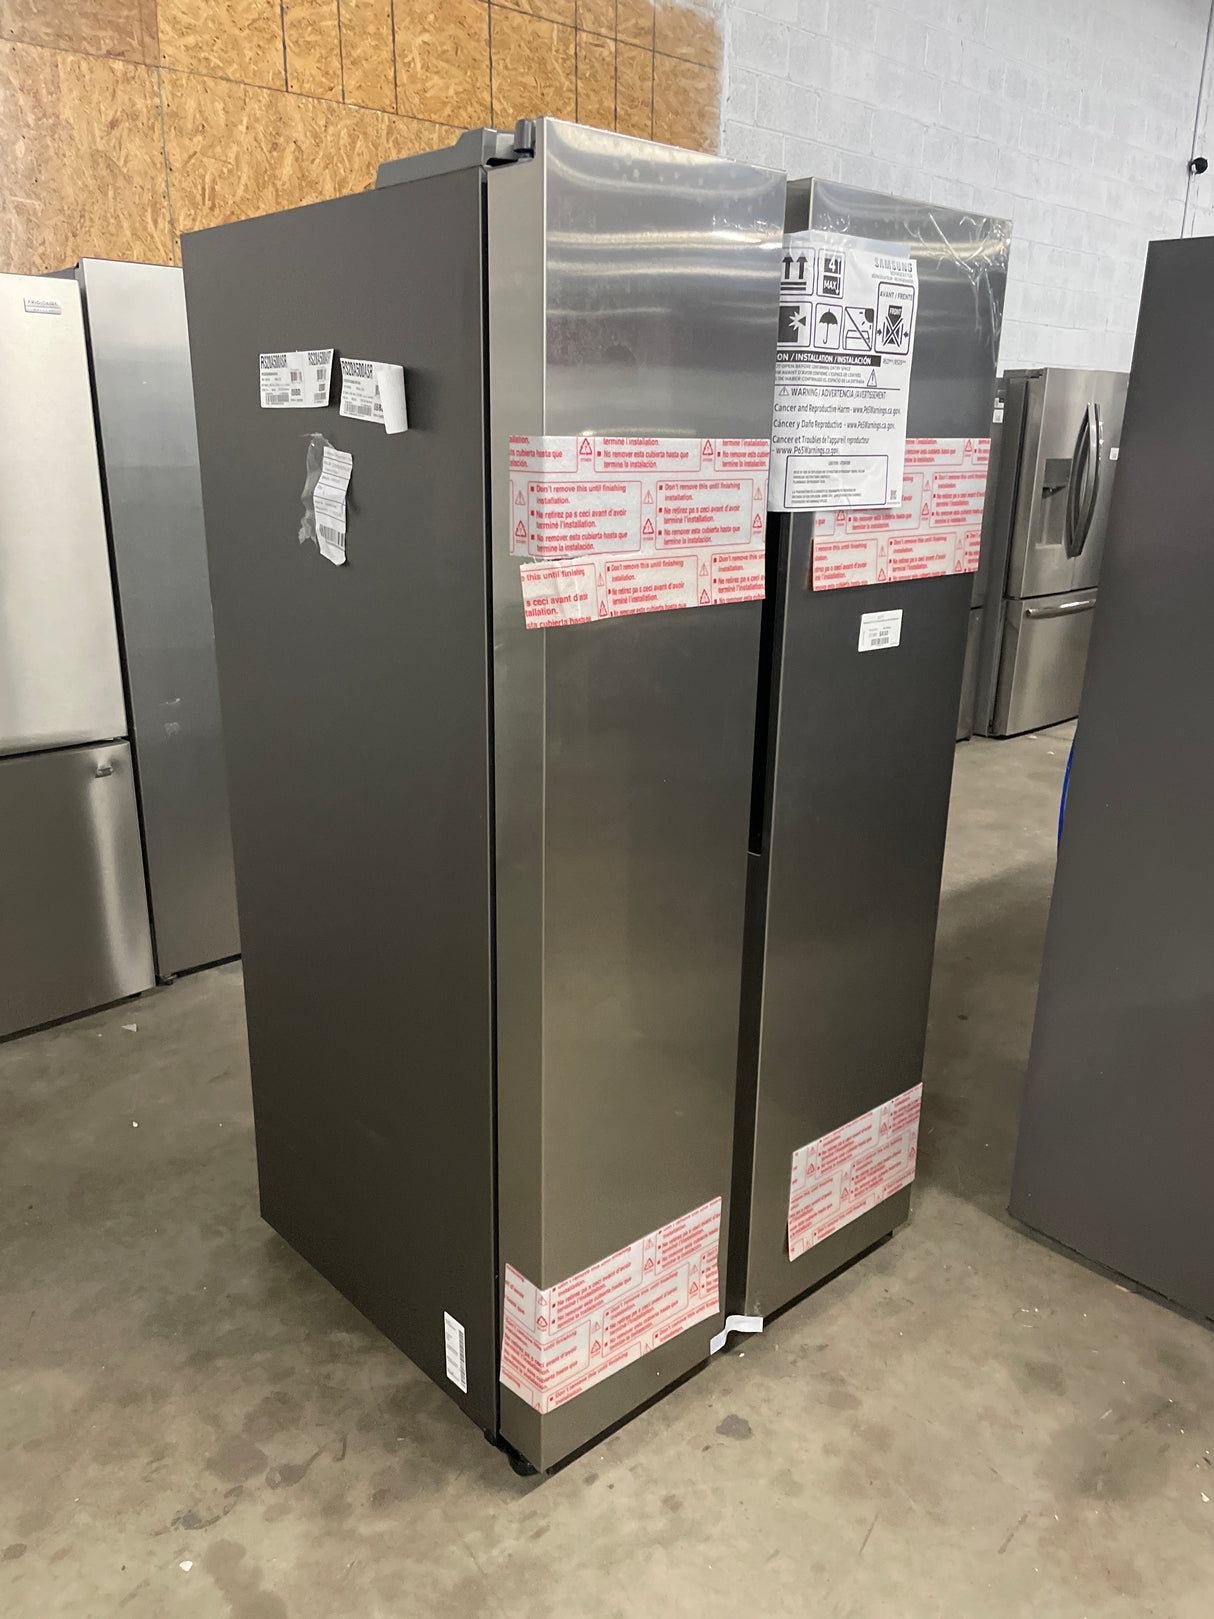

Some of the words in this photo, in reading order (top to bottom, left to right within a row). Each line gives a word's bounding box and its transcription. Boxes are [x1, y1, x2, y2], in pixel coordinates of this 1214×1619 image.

[829, 255, 836, 272] 4
[874, 257, 913, 273] SAMSUNG
[823, 280, 837, 290] MAX
[795, 354, 833, 364] INSTALLATION
[791, 387, 818, 398] WARNING
[774, 403, 796, 412] Cancer
[797, 404, 808, 412] and
[809, 404, 837, 414] Reproductive
[773, 419, 796, 428] Cáncer
[796, 422, 801, 430] y
[801, 420, 814, 429] Daño
[772, 435, 794, 444] Cancer
[794, 436, 802, 444] et
[802, 435, 821, 444] Troubles
[536, 485, 552, 493] Don't
[576, 485, 588, 493] this
[588, 484, 601, 493] until
[602, 485, 627, 494] finishing
[664, 483, 679, 491] Don't
[699, 482, 708, 490] this
[709, 482, 720, 490] until
[720, 482, 741, 491] finishing
[536, 497, 570, 505] installation.
[536, 511, 543, 519] Ne
[545, 510, 564, 519] retirez
[565, 511, 573, 520] pa
[578, 510, 591, 518] ceci
[592, 510, 607, 518] avant
[608, 508, 627, 517] d'avoir
[537, 534, 544, 542] No
[545, 534, 569, 542] remover
[582, 532, 603, 540] cubierta
[603, 531, 618, 540] hasta
[618, 532, 628, 541] que
